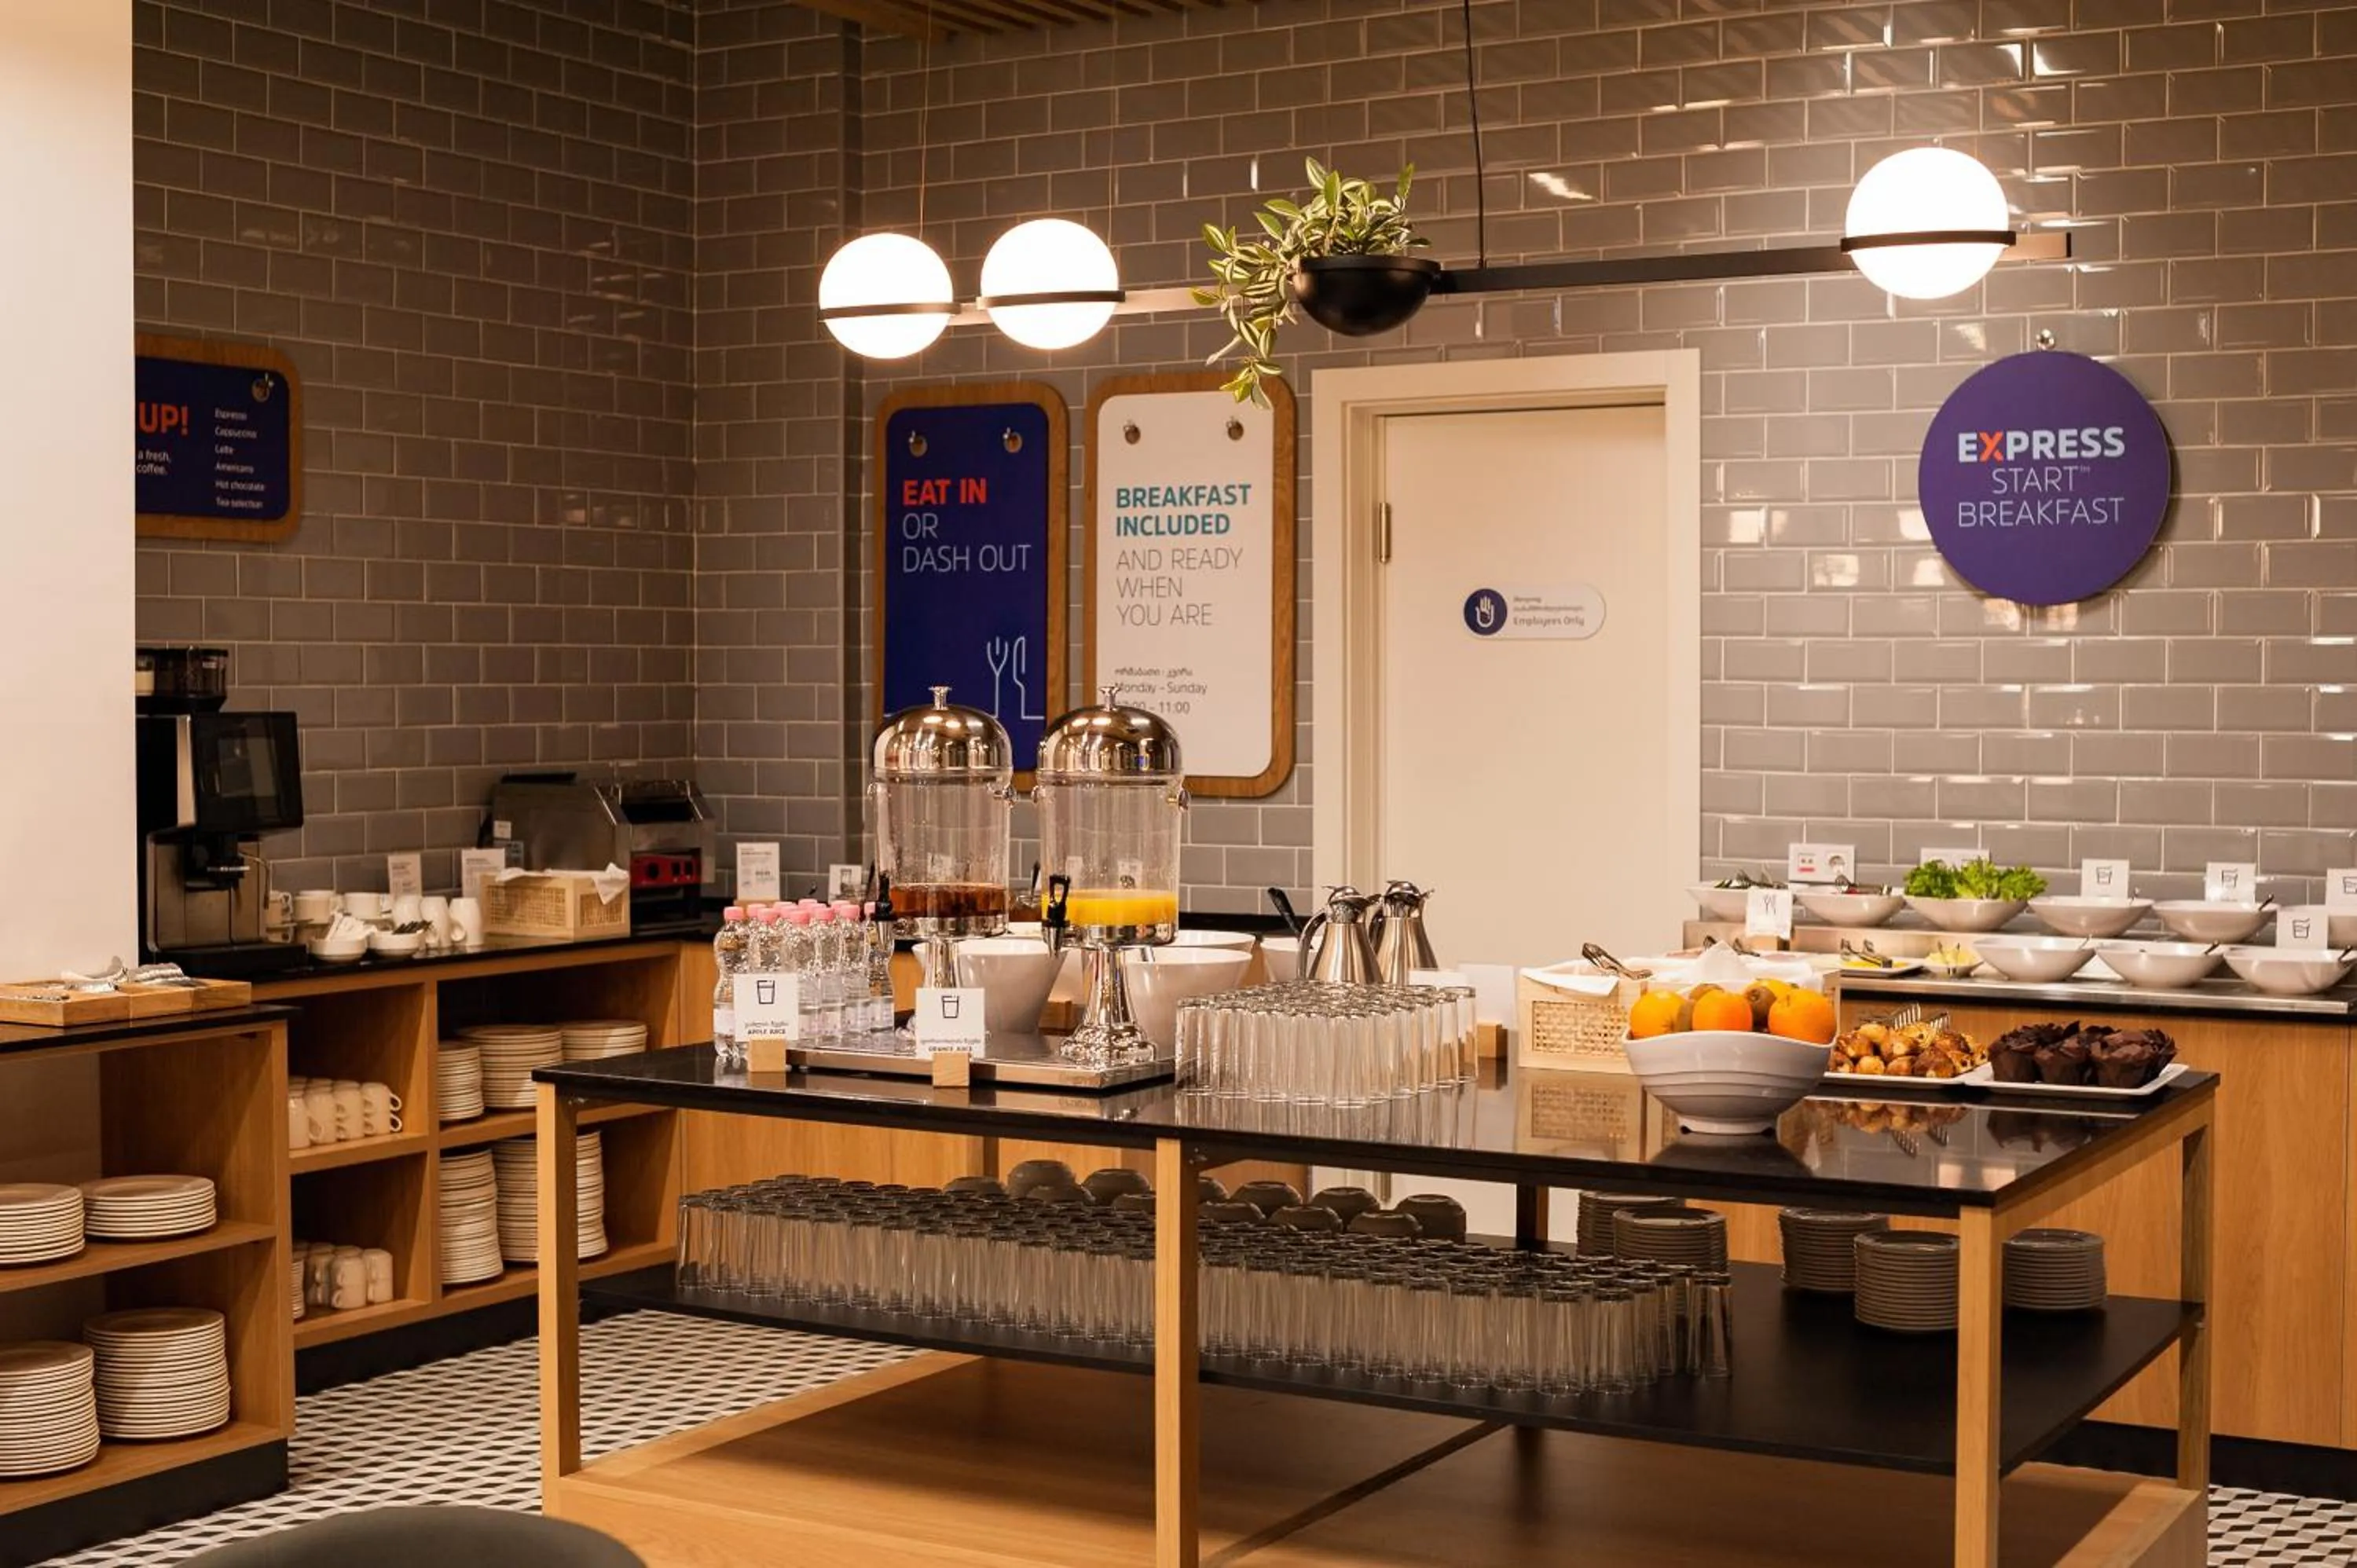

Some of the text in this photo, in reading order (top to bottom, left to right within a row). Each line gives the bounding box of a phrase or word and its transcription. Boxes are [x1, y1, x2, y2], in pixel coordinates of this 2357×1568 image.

[138, 401, 189, 435] UP!
[137, 450, 144, 460] a
[1958, 427, 2125, 463] EXPRESS
[903, 478, 987, 505] EAT IN
[1116, 484, 1252, 508] BREAKFAST
[1959, 496, 2125, 528] BREAKFAST
[903, 512, 939, 540] OR
[1116, 513, 1230, 537] INCLUDED
[903, 544, 1032, 573] DASH OUT
[1116, 547, 1244, 571] AND READY
[1116, 576, 1183, 599] WHEN
[1116, 603, 1213, 626] YOU ARE
[1513, 615, 1585, 628] Employees Only
[1167, 681, 1208, 695] Sunday
[1159, 701, 1191, 714] 11:00
